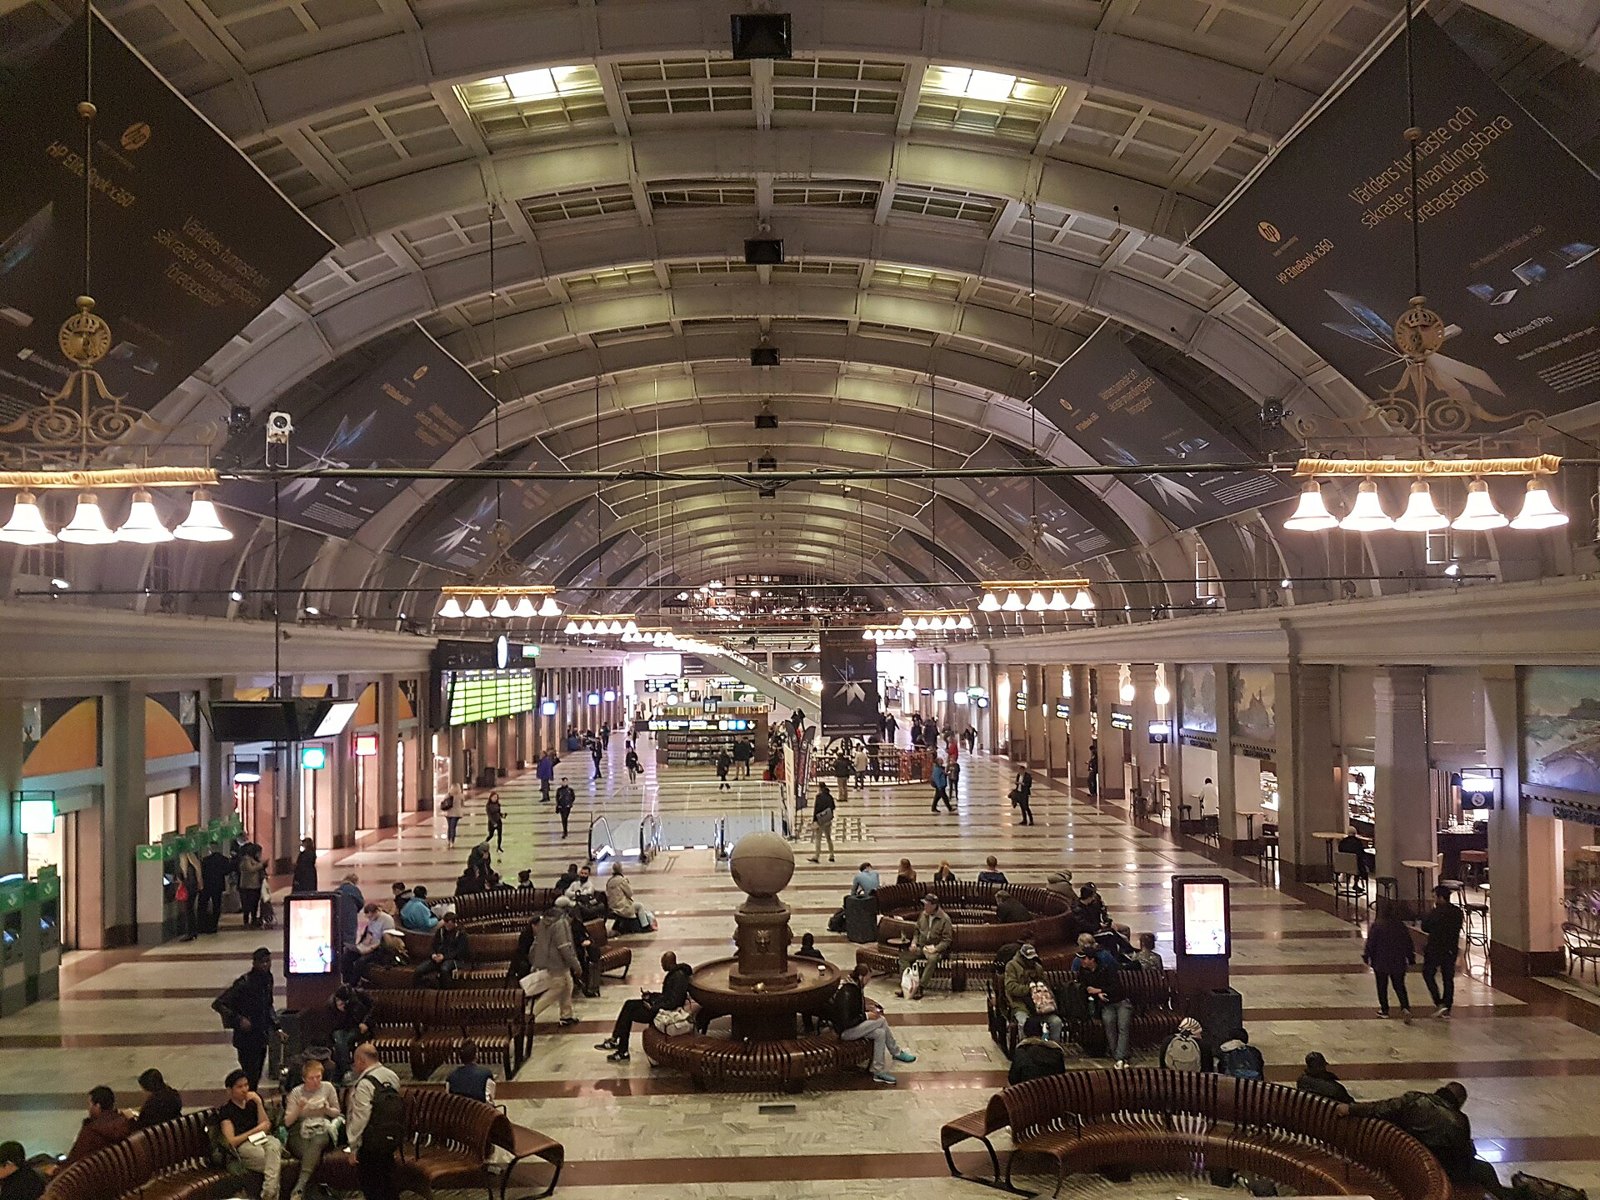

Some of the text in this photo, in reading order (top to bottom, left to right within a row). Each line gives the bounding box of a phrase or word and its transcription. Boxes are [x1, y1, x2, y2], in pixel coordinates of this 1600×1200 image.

[1348, 166, 1400, 205] Världens
[1447, 105, 1477, 132] och
[1257, 221, 1280, 243] hp
[1361, 193, 1408, 230] säkraste
[1276, 272, 1289, 285] HP
[1284, 252, 1318, 279] EliteBook
[1313, 238, 1335, 258] x360
